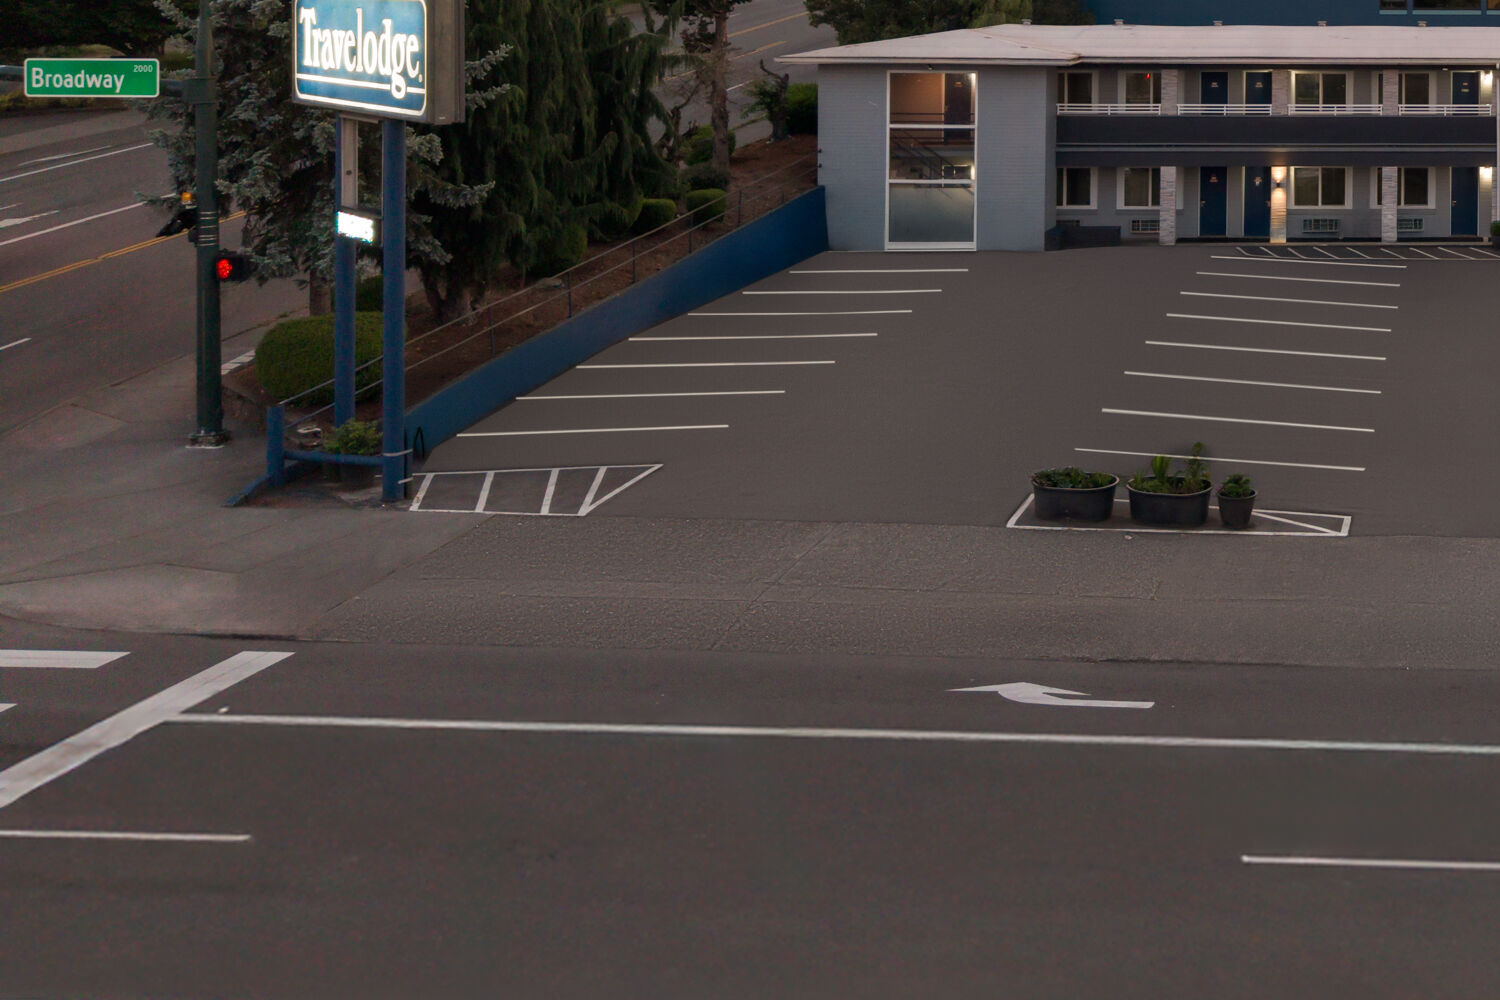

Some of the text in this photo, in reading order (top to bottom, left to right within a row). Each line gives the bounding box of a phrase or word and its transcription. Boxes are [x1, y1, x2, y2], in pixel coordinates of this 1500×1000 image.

[299, 6, 420, 99] Travelodge
[31, 67, 125, 93] Broadway
[133, 64, 153, 73] 2000
